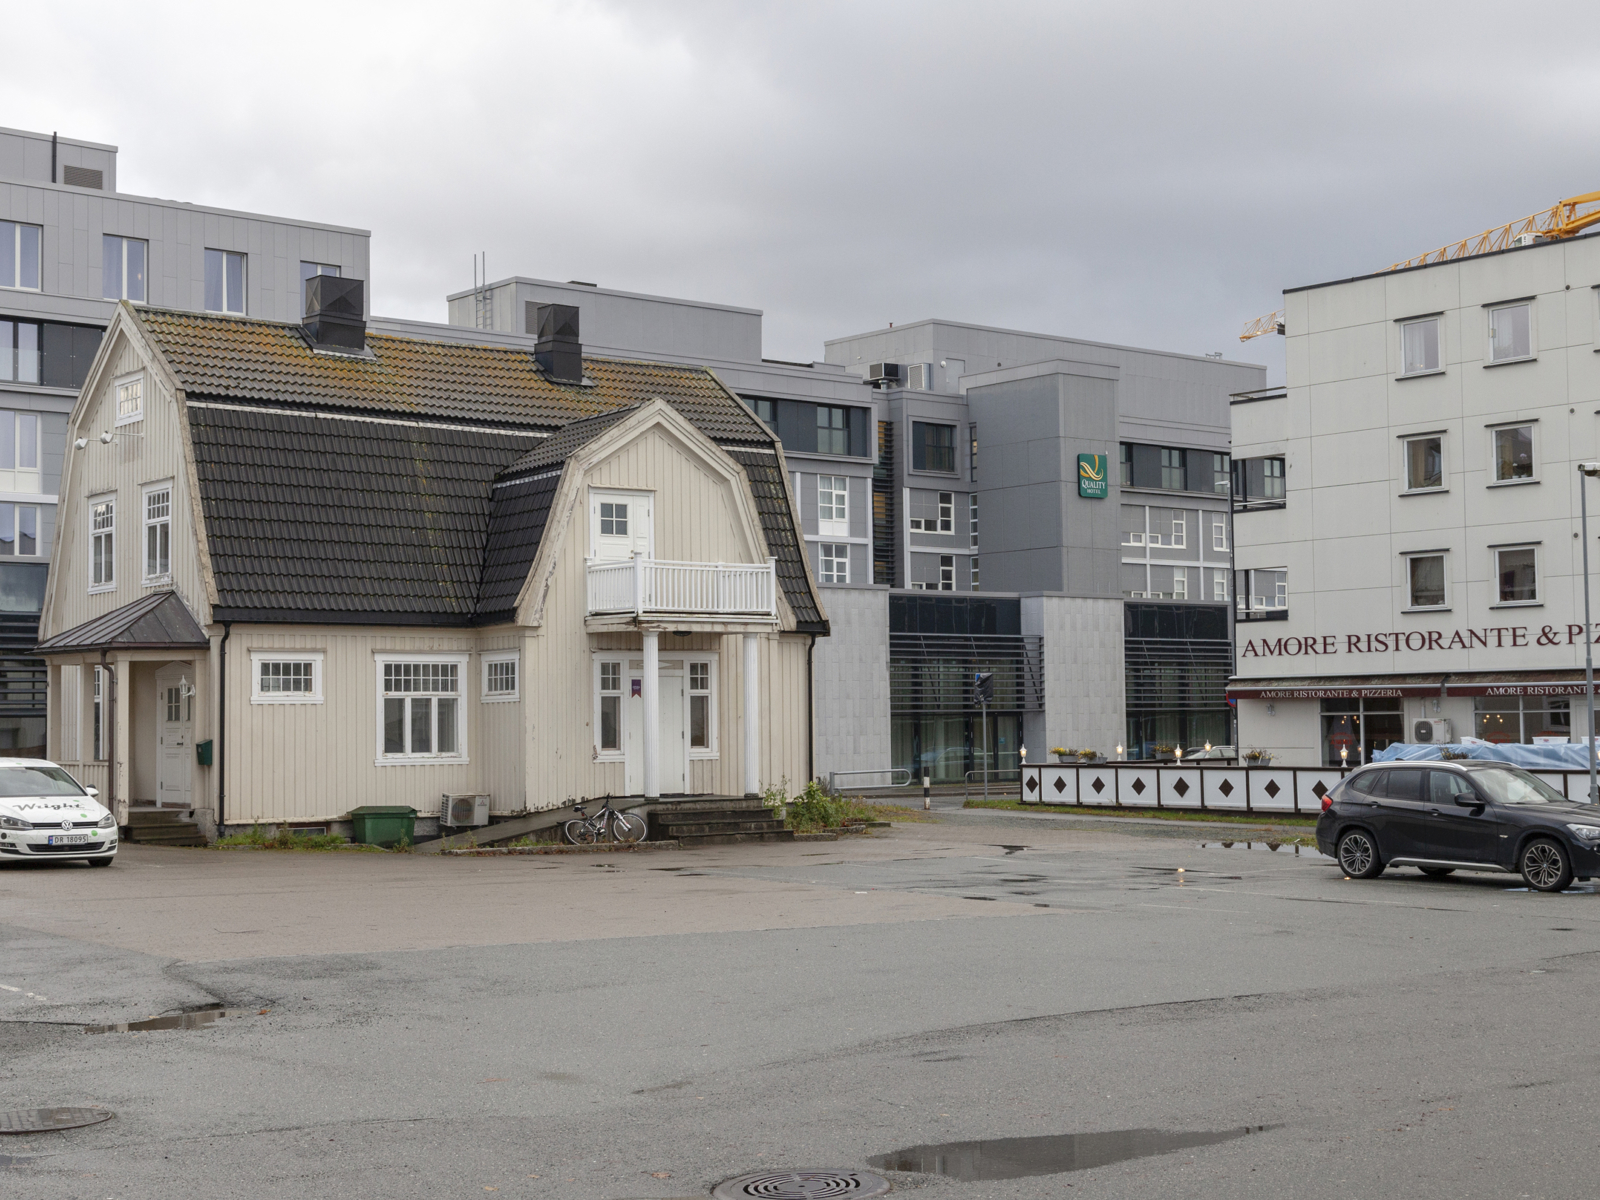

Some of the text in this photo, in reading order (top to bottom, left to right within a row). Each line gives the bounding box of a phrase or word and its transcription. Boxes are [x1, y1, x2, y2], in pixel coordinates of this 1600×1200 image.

[1081, 479, 1106, 489] QUALITY
[1241, 635, 1338, 658] AMORE
[1345, 626, 1529, 654] RISTORANTE
[1536, 625, 1561, 646] &
[1260, 689, 1403, 698] AMORE RISTORANTE & PIZZERIA
[1486, 687, 1524, 695] AMORE
[1527, 685, 1596, 695] RISTORANT
[54, 836, 64, 844] DR
[66, 835, 87, 843] 18095
